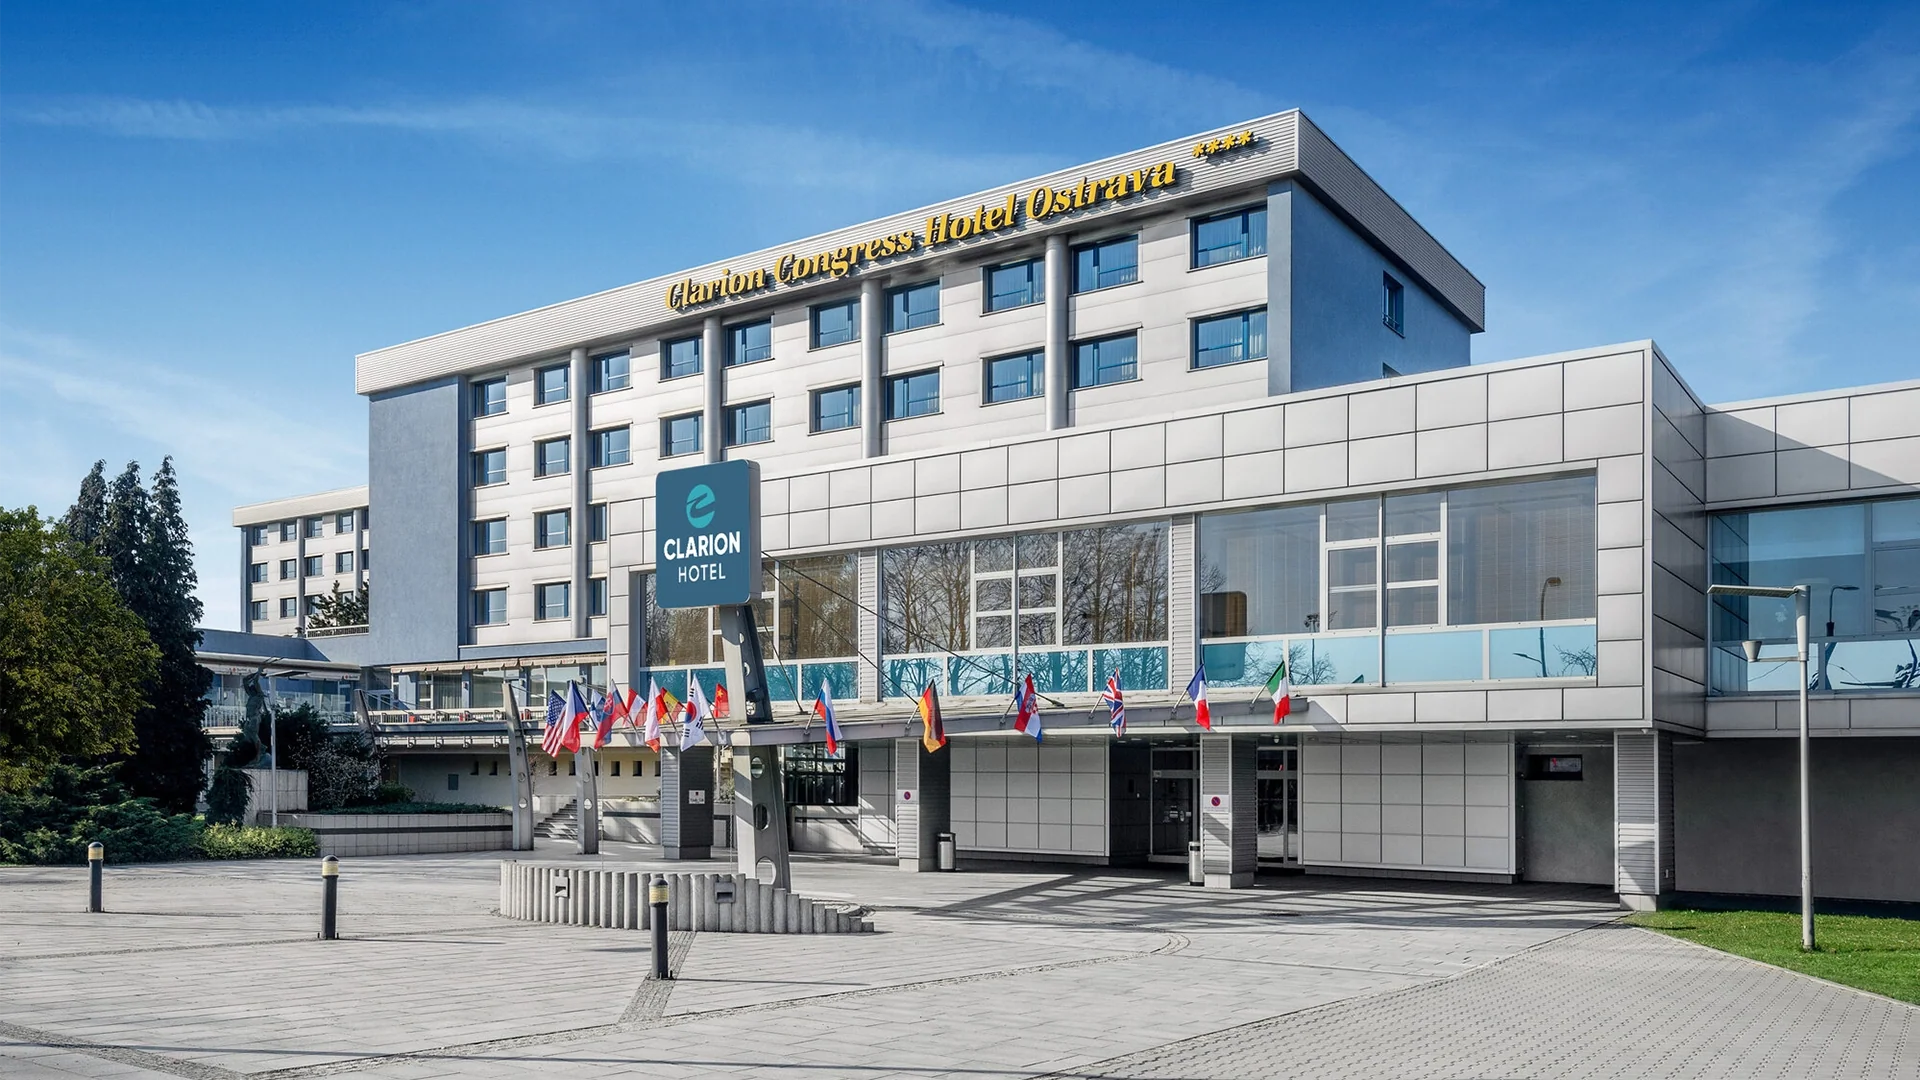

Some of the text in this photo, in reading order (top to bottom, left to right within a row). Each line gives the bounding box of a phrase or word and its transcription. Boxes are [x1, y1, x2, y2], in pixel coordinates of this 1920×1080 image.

[665, 159, 1176, 310] Clarion Congress Hotel Ostrava
[663, 530, 741, 561] CLARION
[678, 562, 726, 583] HOTEL
